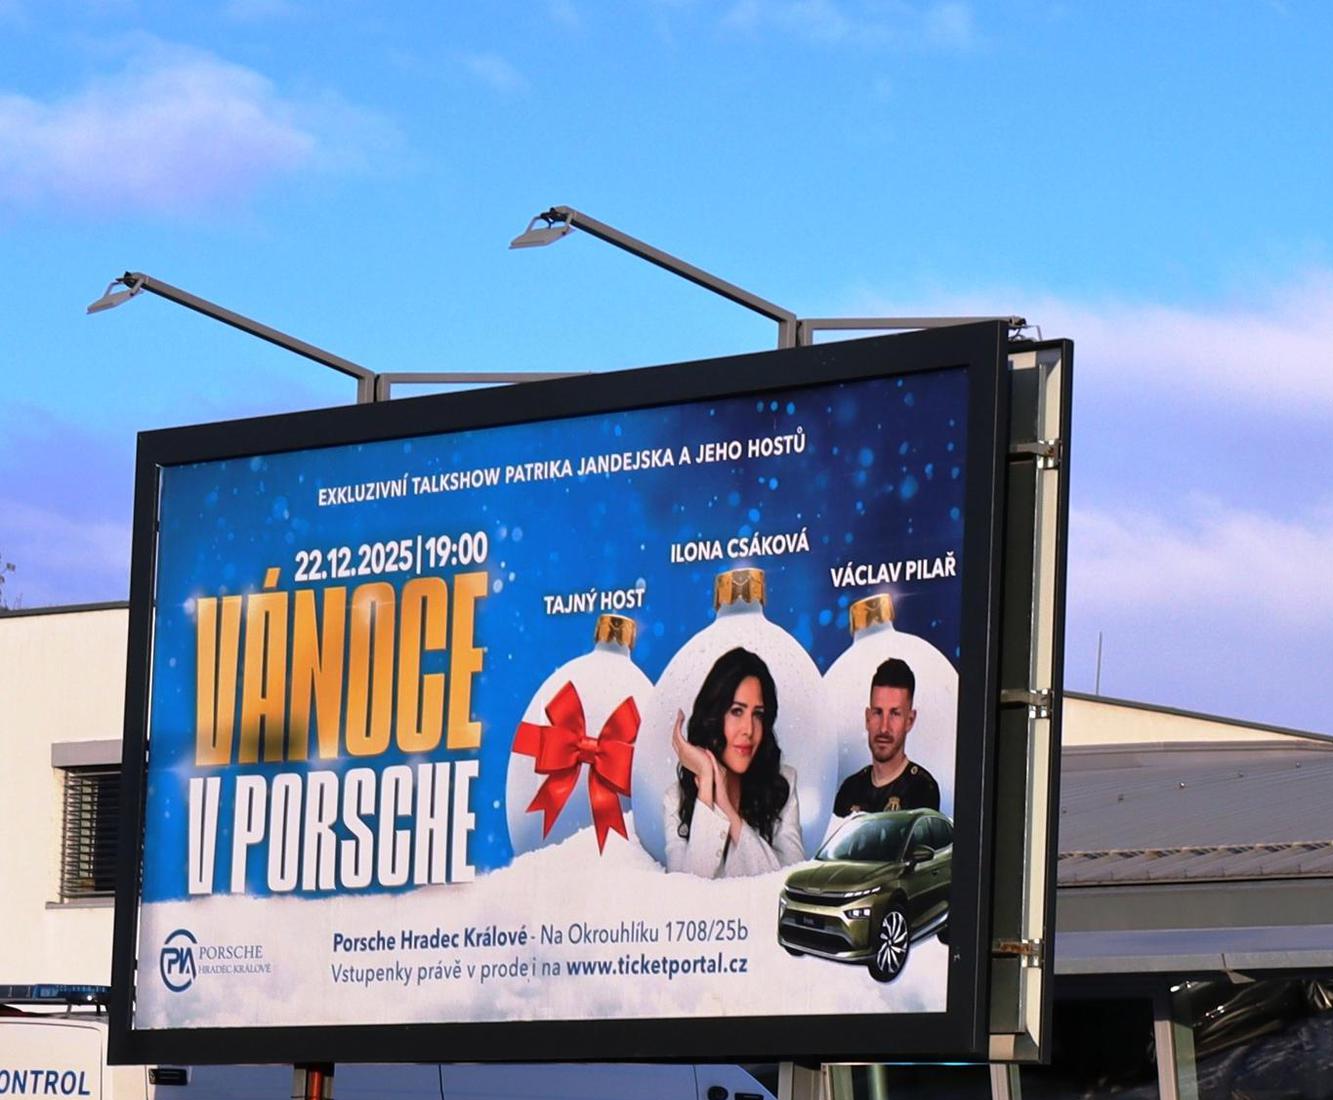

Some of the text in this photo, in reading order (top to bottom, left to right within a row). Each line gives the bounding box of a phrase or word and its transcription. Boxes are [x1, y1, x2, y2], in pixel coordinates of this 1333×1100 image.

[318, 426, 806, 506] EXKLUZIVNÍ TALKSHOW PATRIKA JANDEJSKA A JEHO HOSTŮ
[670, 527, 809, 563] ILONA CSÁKOVÁ
[830, 551, 956, 588] VÁCLAV PILAŘ
[543, 588, 646, 616] TAJNÝ HOST
[194, 567, 489, 766] VÁNOCE
[187, 760, 480, 894] V PORSCHE
[199, 945, 264, 961] PORSCHE
[333, 930, 396, 952] Porsche
[400, 927, 460, 949] Hradec
[464, 924, 528, 947] Králové
[540, 925, 563, 945] Na
[568, 921, 659, 945] Okrouhlíku
[665, 918, 749, 942] 1708/25b
[331, 960, 413, 988] Vstupenky
[417, 959, 462, 986] právě
[467, 965, 476, 979] v
[542, 961, 561, 977] na
[566, 952, 748, 980] www.ticketportal.cz
[0, 1070, 91, 1096] ONTROL
